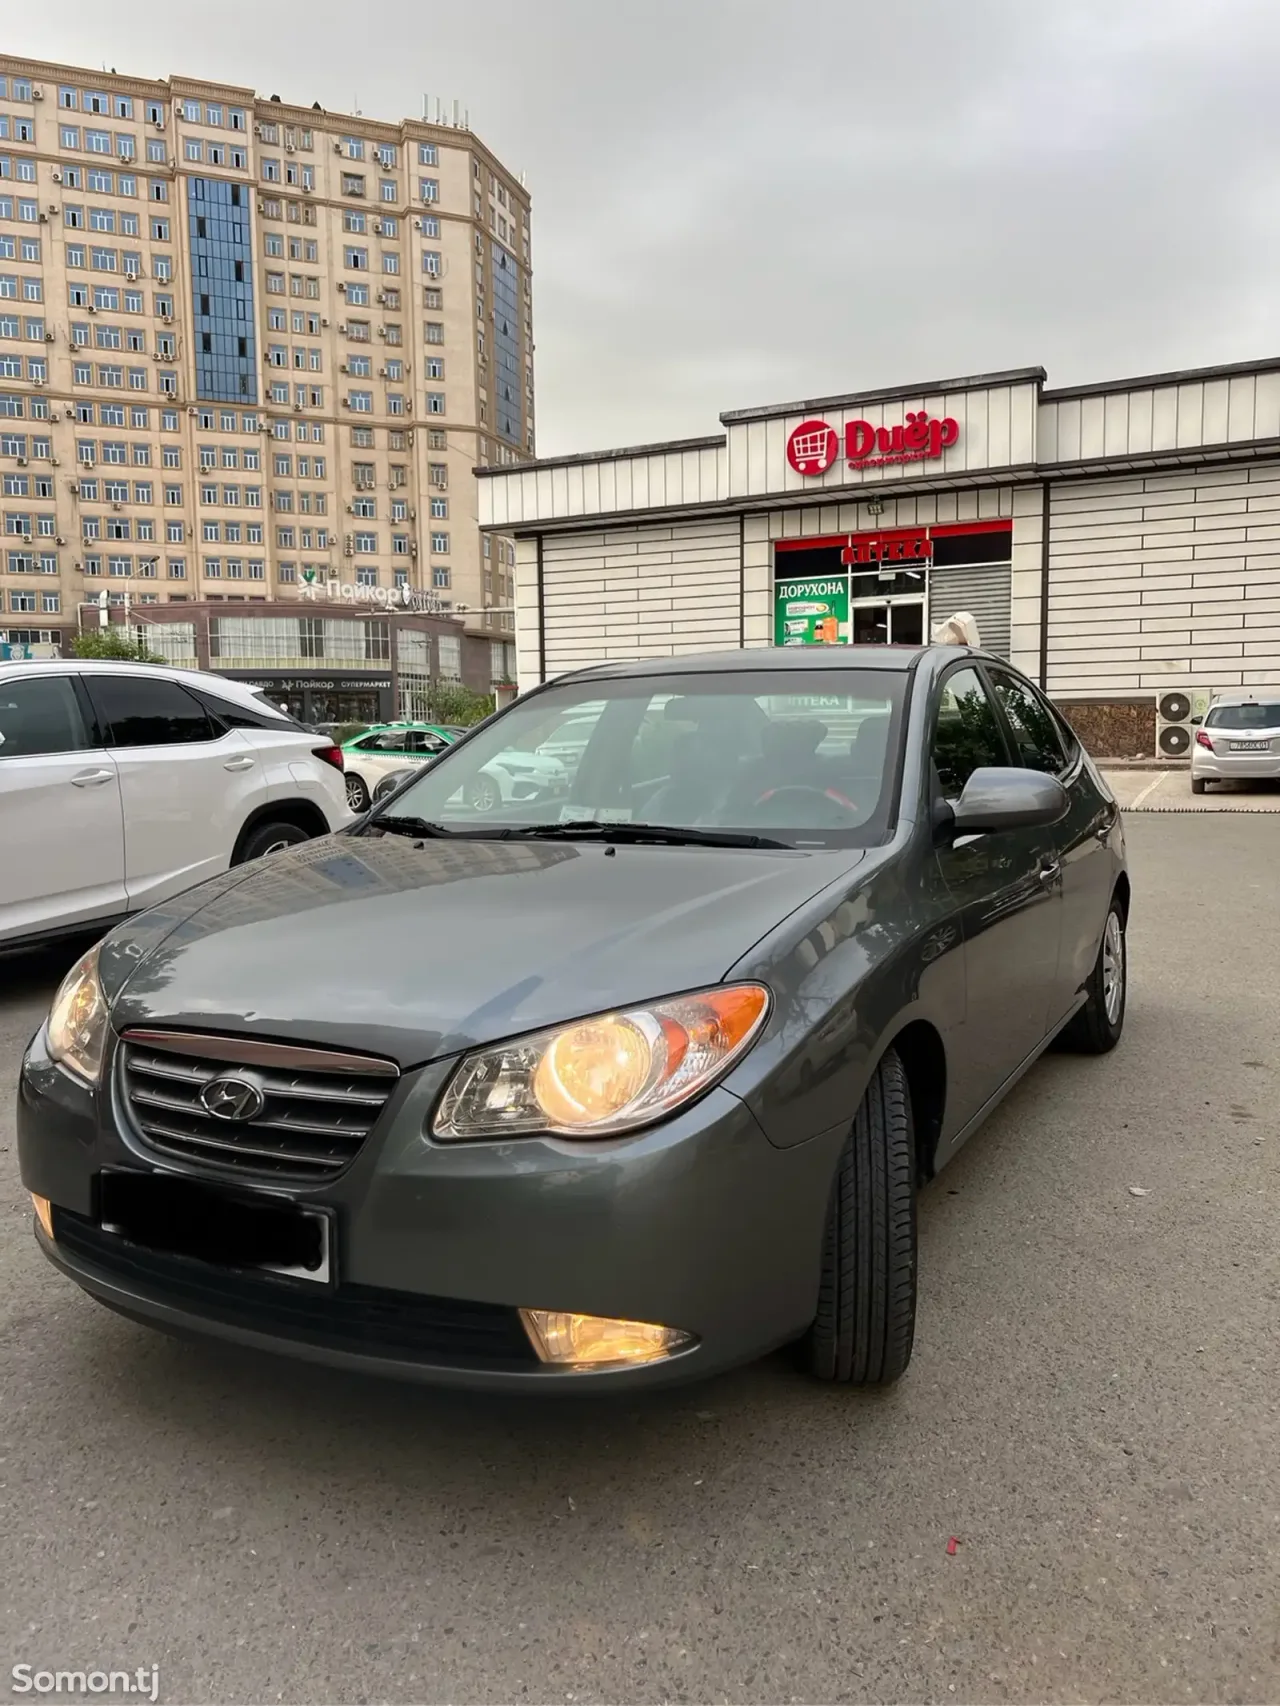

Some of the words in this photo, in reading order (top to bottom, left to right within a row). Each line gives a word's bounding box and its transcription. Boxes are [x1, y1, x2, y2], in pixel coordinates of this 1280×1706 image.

[841, 540, 933, 565] АПТЕКА
[327, 579, 400, 606] Пайкар
[779, 581, 844, 599] ДОРУХОНА
